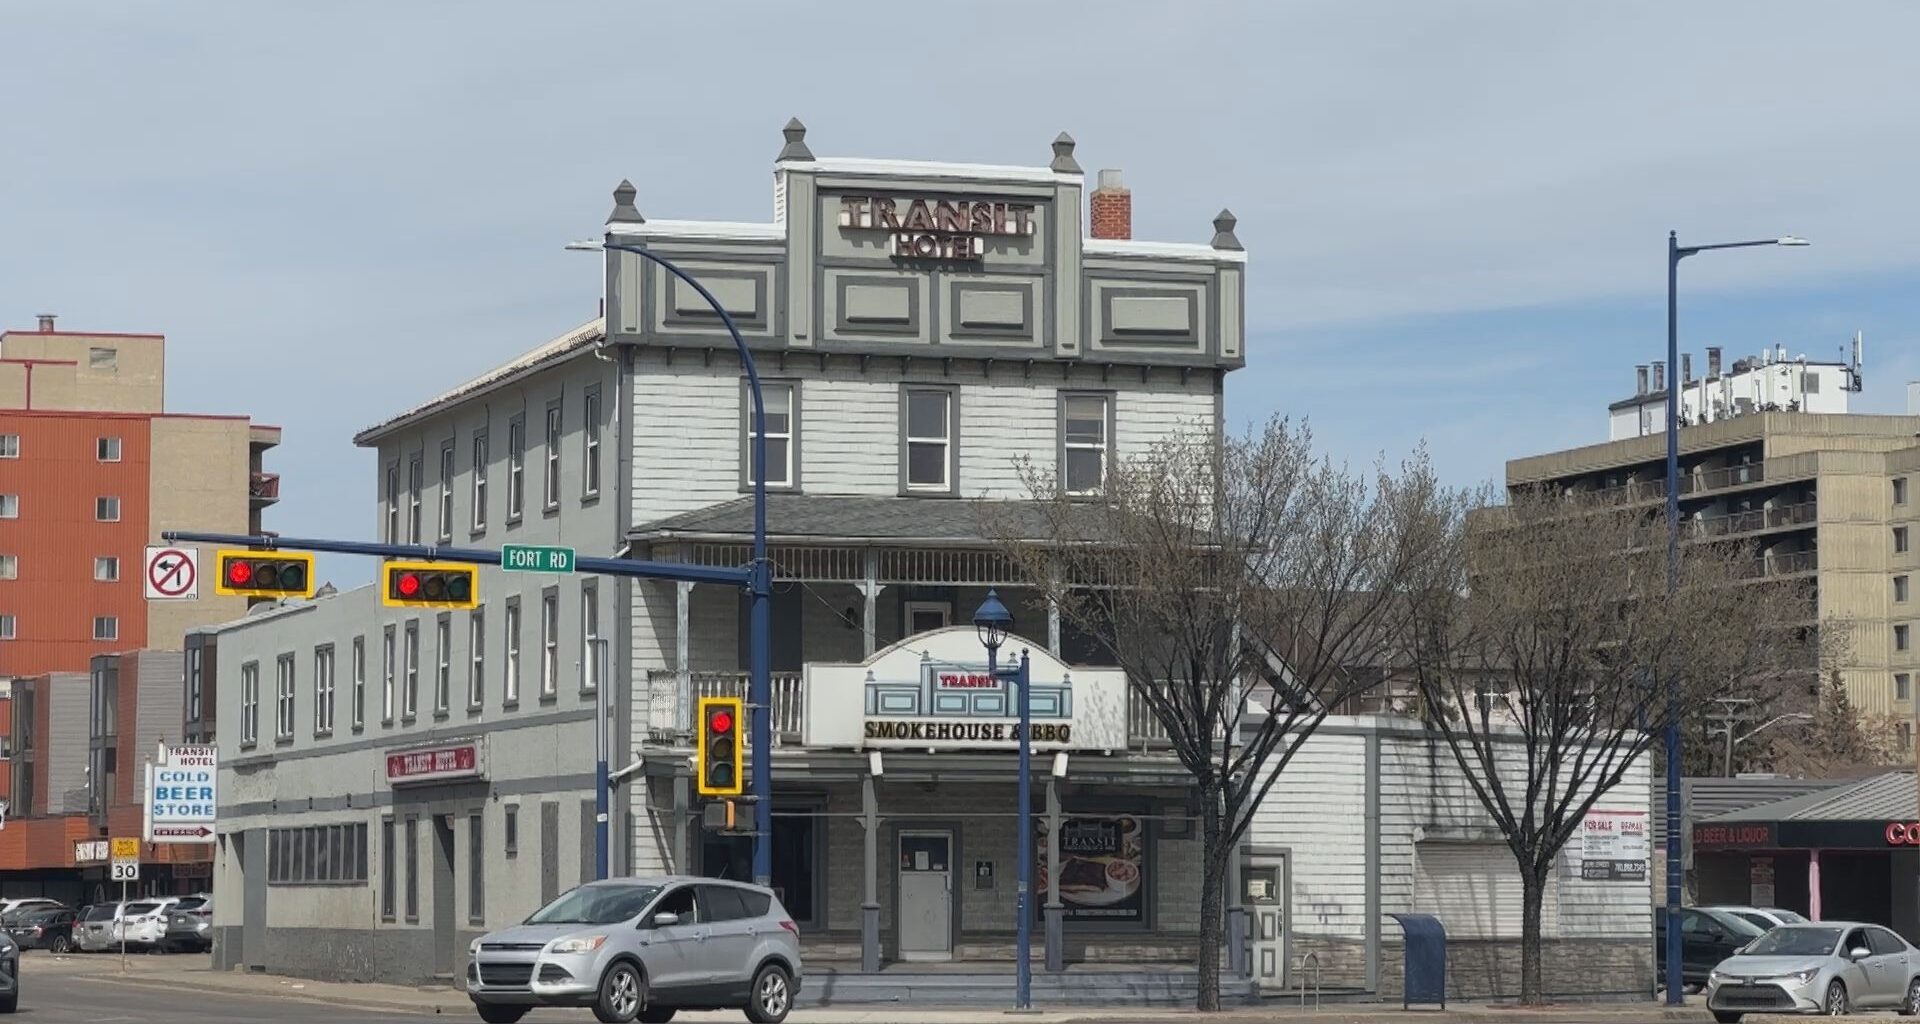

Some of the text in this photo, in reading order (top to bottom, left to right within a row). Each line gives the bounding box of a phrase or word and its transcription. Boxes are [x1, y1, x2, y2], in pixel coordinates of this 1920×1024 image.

[840, 195, 1035, 234] TRANSIT
[897, 235, 983, 258] HOTEL
[509, 549, 567, 569] FORT RD
[939, 674, 999, 688] TRANSIT
[864, 721, 1071, 743] SMOKEHOUSE & BBQ
[168, 747, 215, 756] TRANSIT
[180, 757, 215, 766] HOTEL
[404, 751, 457, 774] TRANSIT HOTEL
[159, 771, 209, 782] COLD
[155, 786, 213, 800] BEER
[154, 803, 214, 816] STORE
[1584, 820, 1613, 831] FOR SALE
[1064, 836, 1116, 846] TRANSIT
[1704, 828, 1727, 843] BEER
[1736, 826, 1769, 842] LIQUOR
[114, 865, 136, 878] 30
